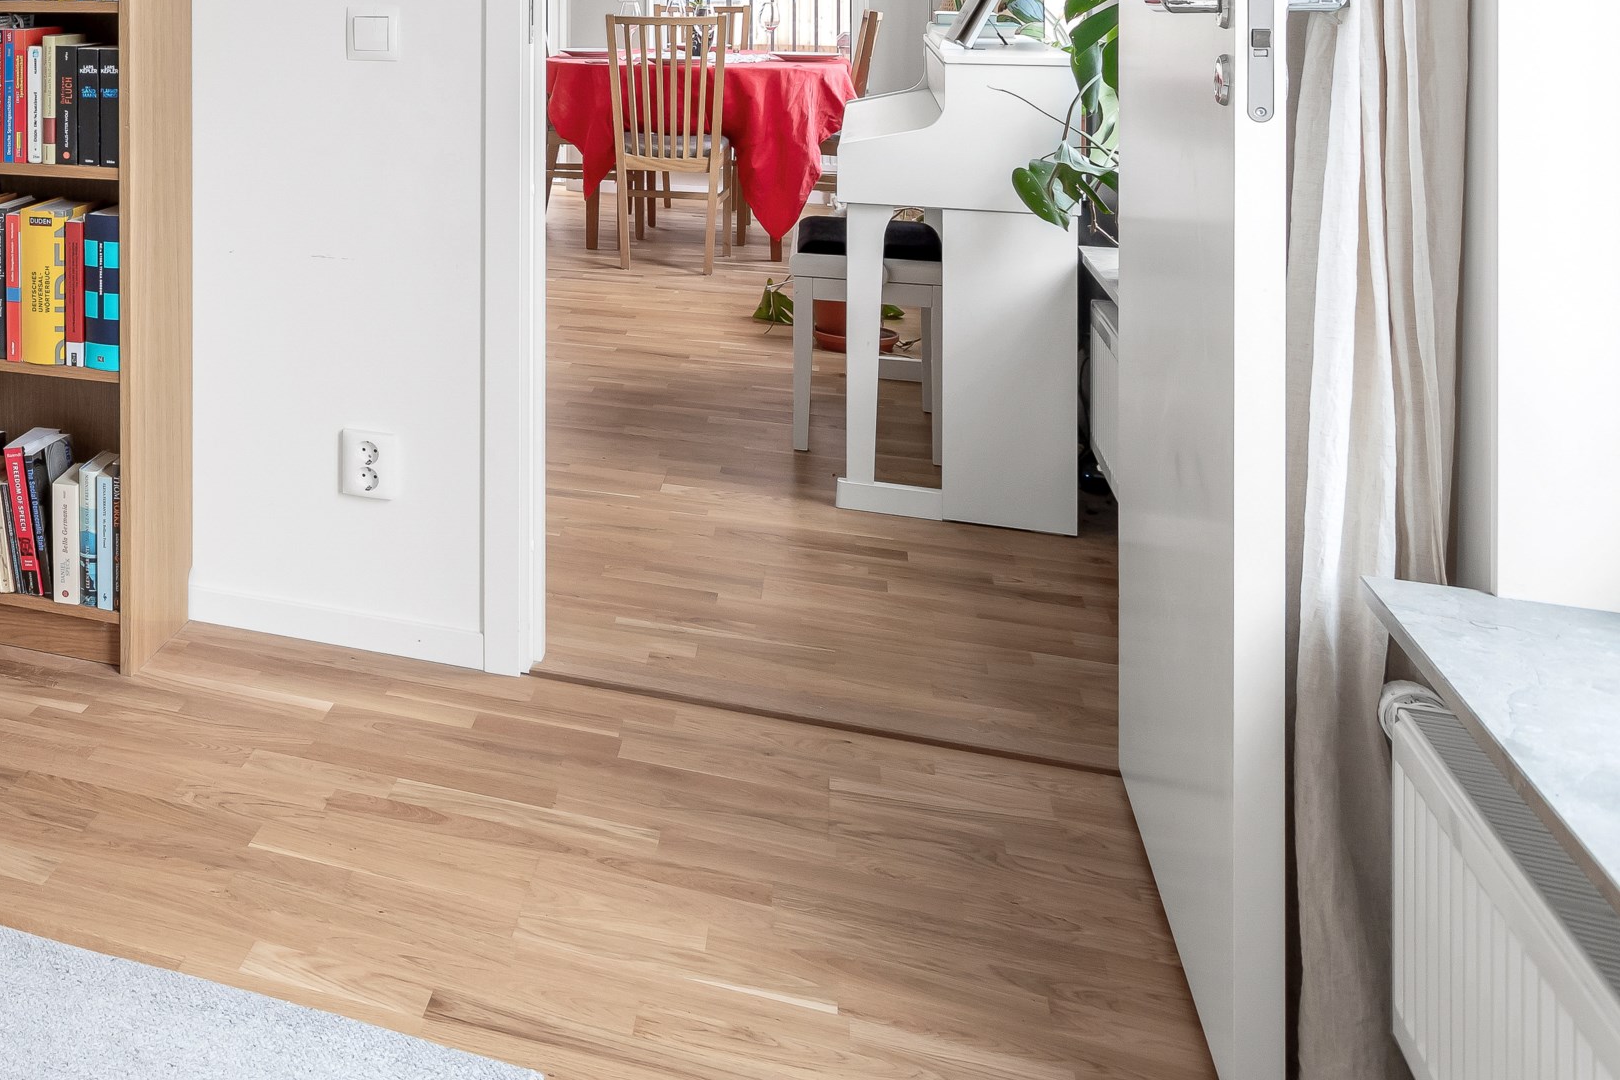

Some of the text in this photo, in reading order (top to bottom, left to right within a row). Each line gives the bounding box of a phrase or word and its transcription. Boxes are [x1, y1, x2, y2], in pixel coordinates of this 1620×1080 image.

[29, 217, 52, 226] DUDEN
[12, 461, 28, 532] FREEDOM OF SPEECH
[28, 480, 36, 499] Social
[31, 500, 41, 534] Democratic
[37, 534, 45, 551] State
